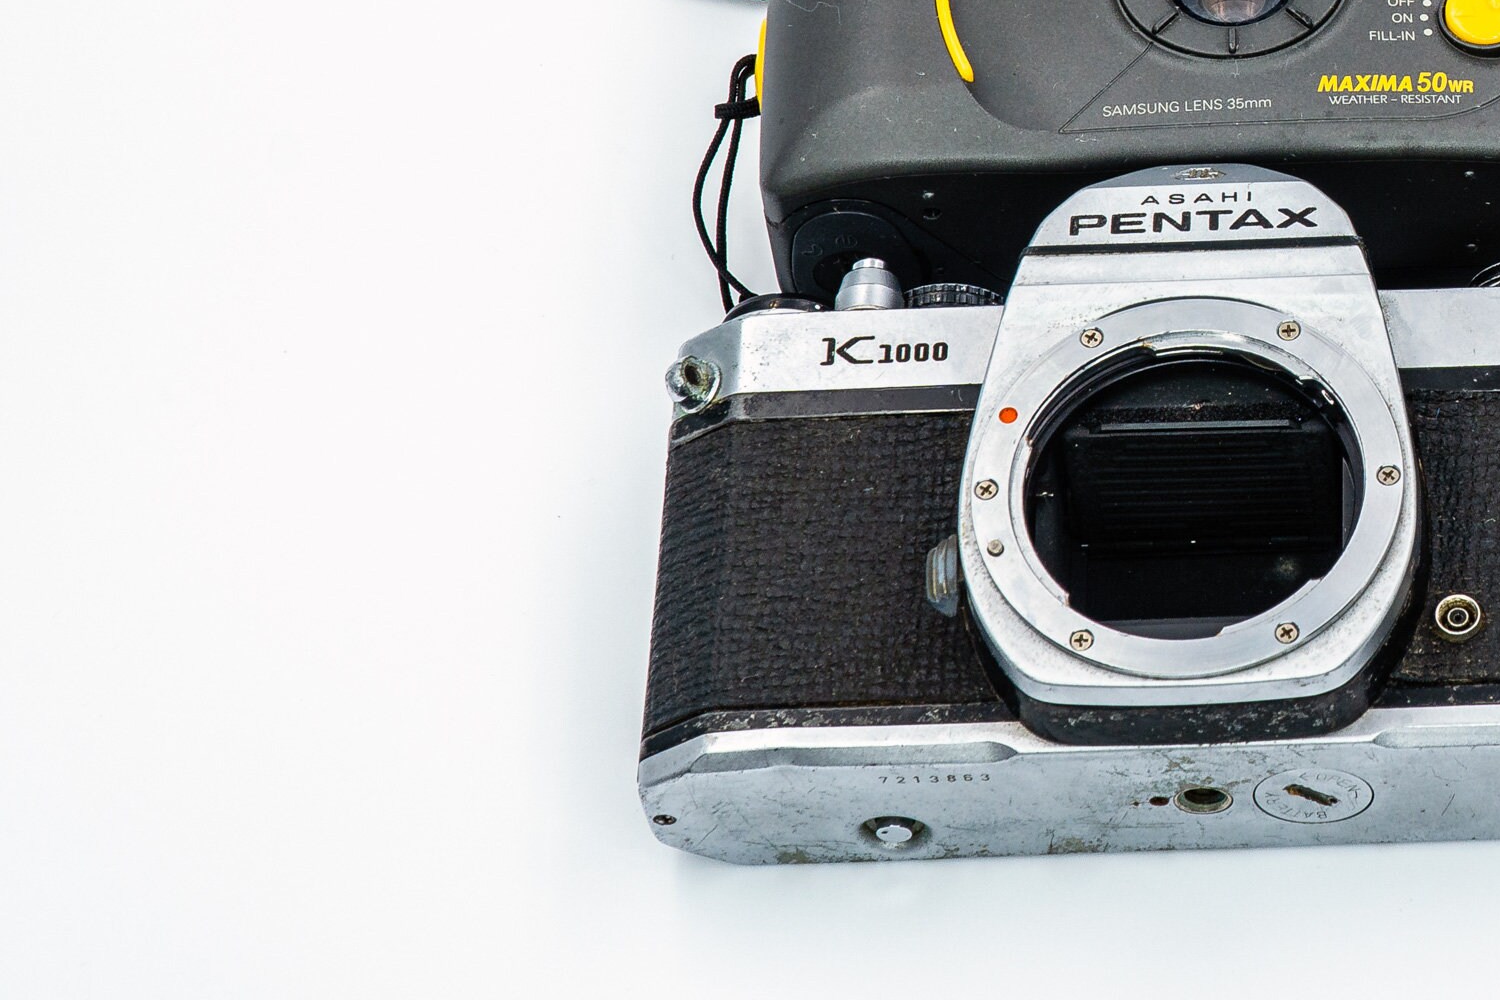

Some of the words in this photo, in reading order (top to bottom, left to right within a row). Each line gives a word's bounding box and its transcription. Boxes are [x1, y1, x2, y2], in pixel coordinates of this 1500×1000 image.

[1392, 13, 1413, 23] ON
[1369, 31, 1415, 41] FILL-IN
[1318, 75, 1412, 92] MAXIMA
[1102, 101, 1180, 117] SAMSUNG
[1185, 99, 1222, 112] LENS
[1227, 98, 1272, 110] 35mm
[1329, 95, 1387, 104] WEATHER
[1401, 95, 1462, 104] RESISTANT
[1141, 191, 1252, 206] ASAHI
[1069, 207, 1318, 236] PENTAX
[820, 336, 948, 366] K1000
